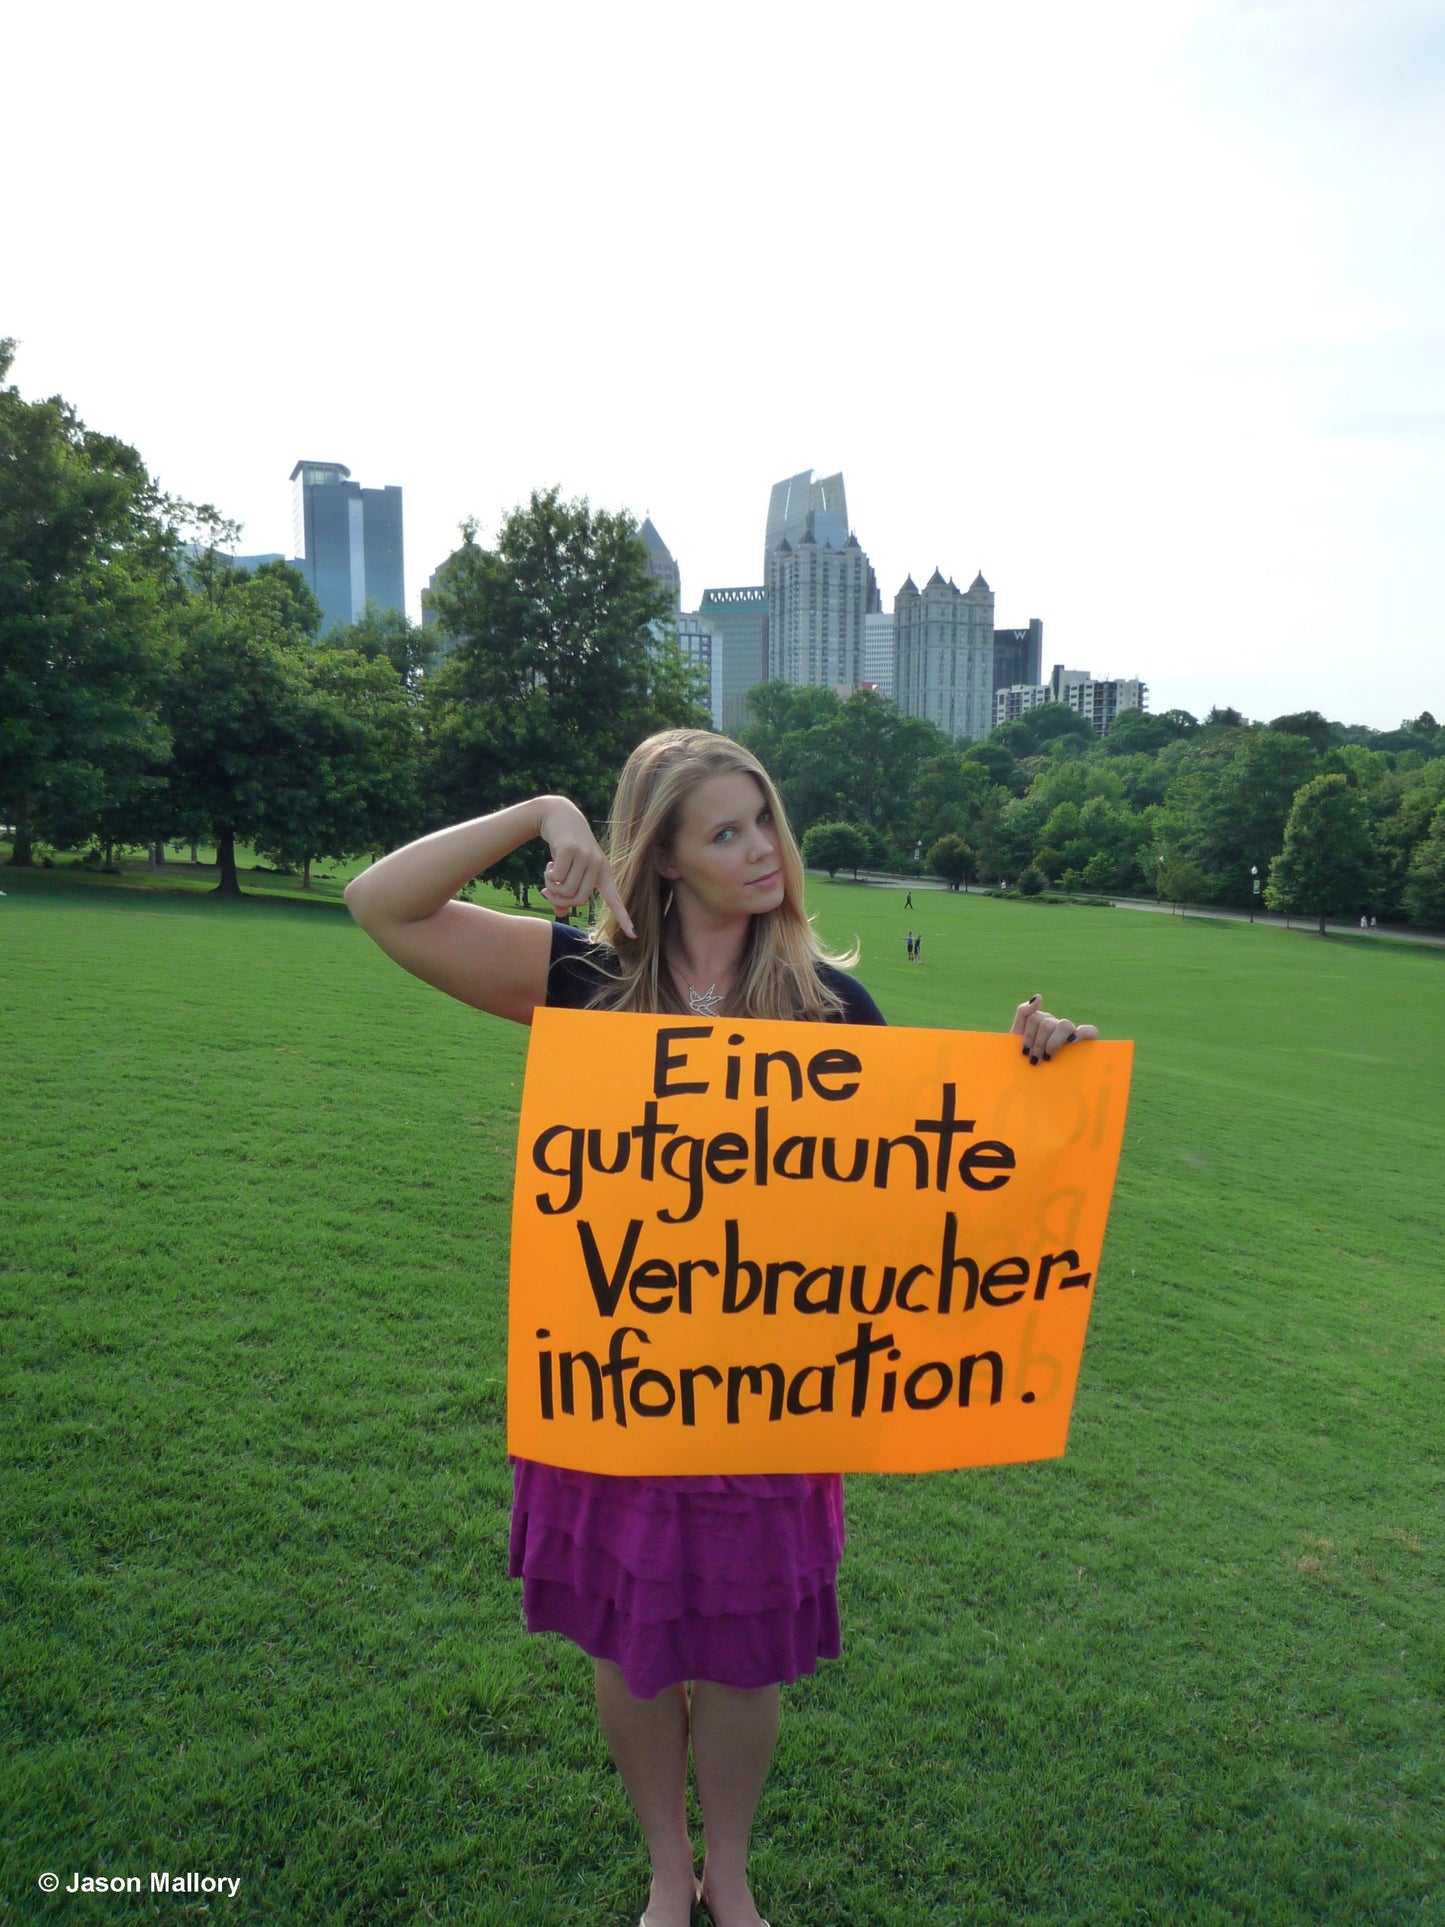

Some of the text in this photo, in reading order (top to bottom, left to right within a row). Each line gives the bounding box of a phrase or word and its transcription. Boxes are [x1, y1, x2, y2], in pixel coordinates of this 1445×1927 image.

[653, 1026, 862, 1101] Eine
[532, 1083, 1016, 1224] gutgelaunte
[577, 1211, 1092, 1317] Verbraucher-
[536, 1322, 1035, 1428] information.
